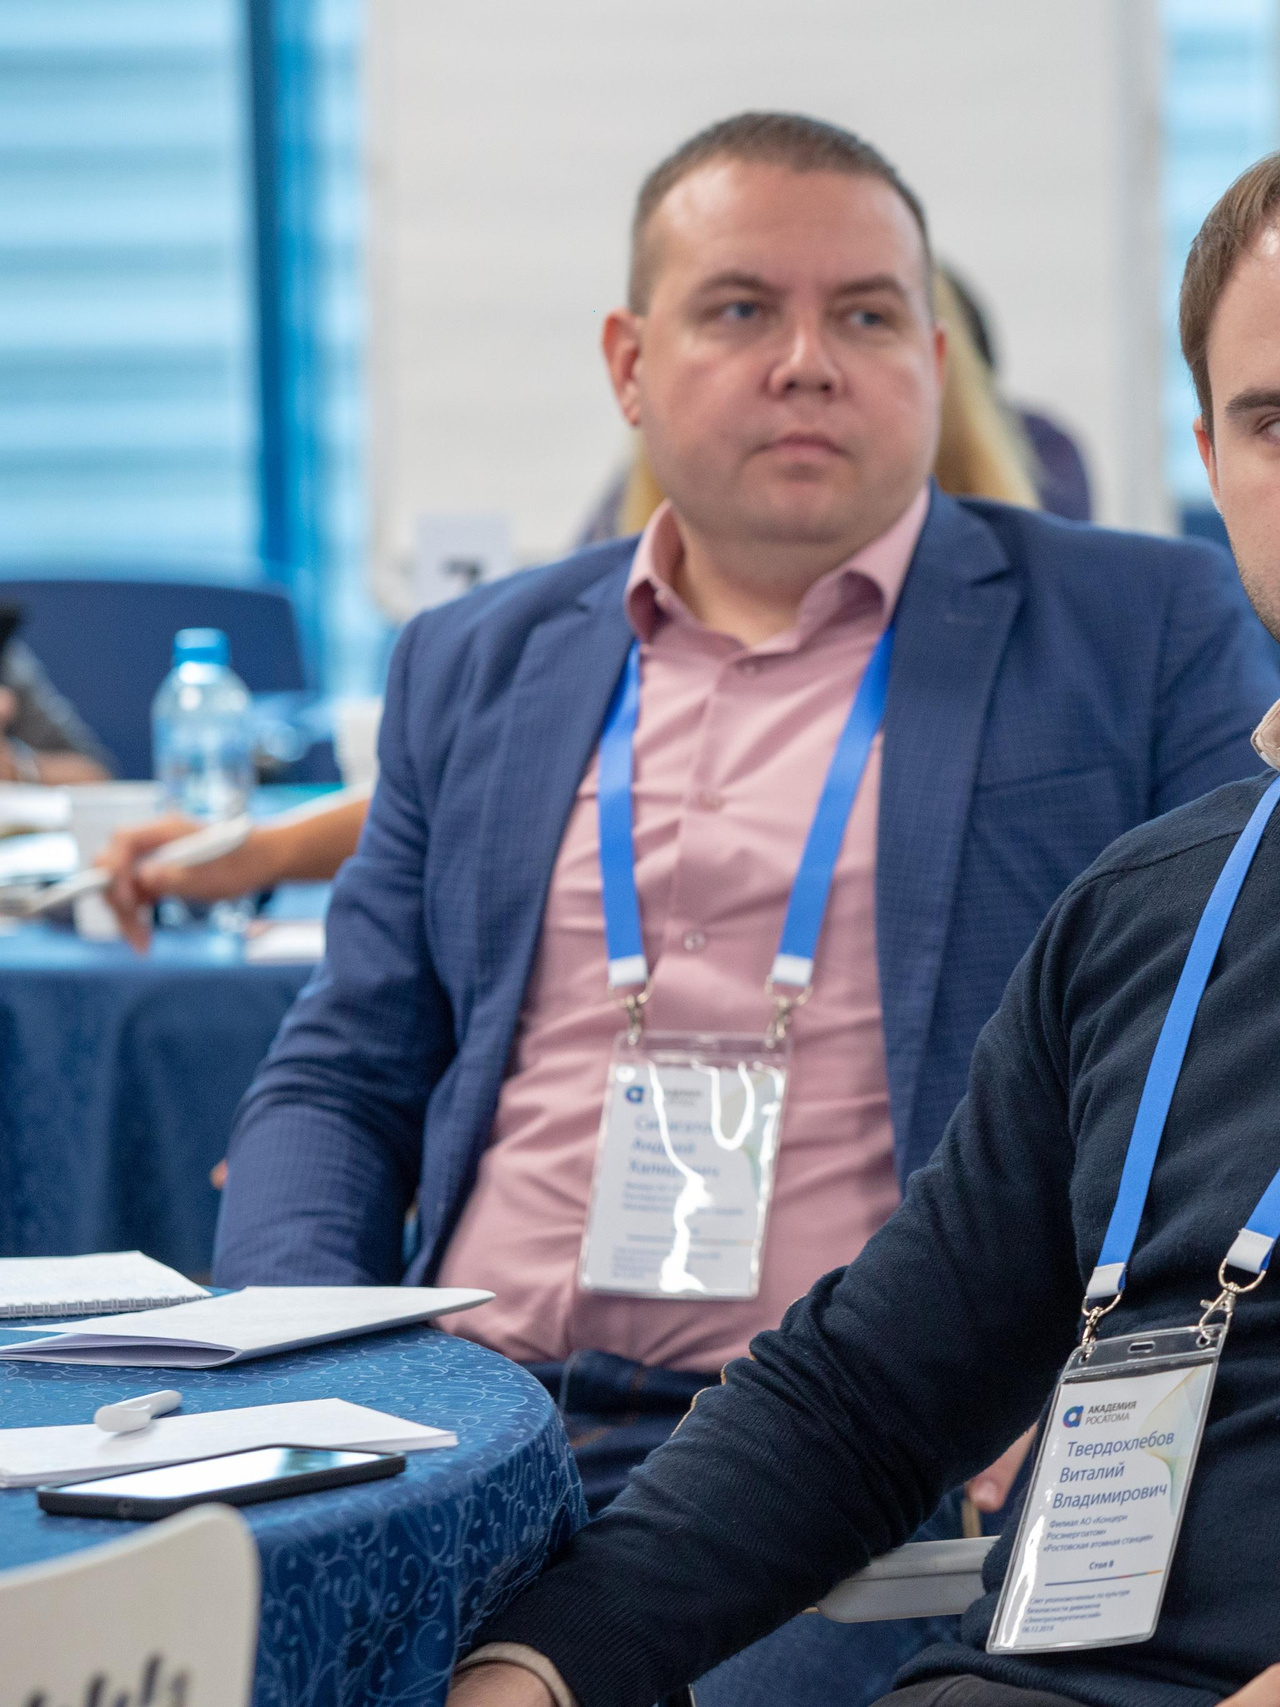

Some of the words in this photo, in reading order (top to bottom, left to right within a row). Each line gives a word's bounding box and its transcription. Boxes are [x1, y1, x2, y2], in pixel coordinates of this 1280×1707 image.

[1085, 1412, 1130, 1425] РОСАТОМА
[1088, 1401, 1137, 1414] АКАДЕМИЯ
[1067, 1430, 1175, 1459] Твердохлебов
[1059, 1461, 1126, 1483] Виталий
[1052, 1484, 1168, 1510] Владимирович
